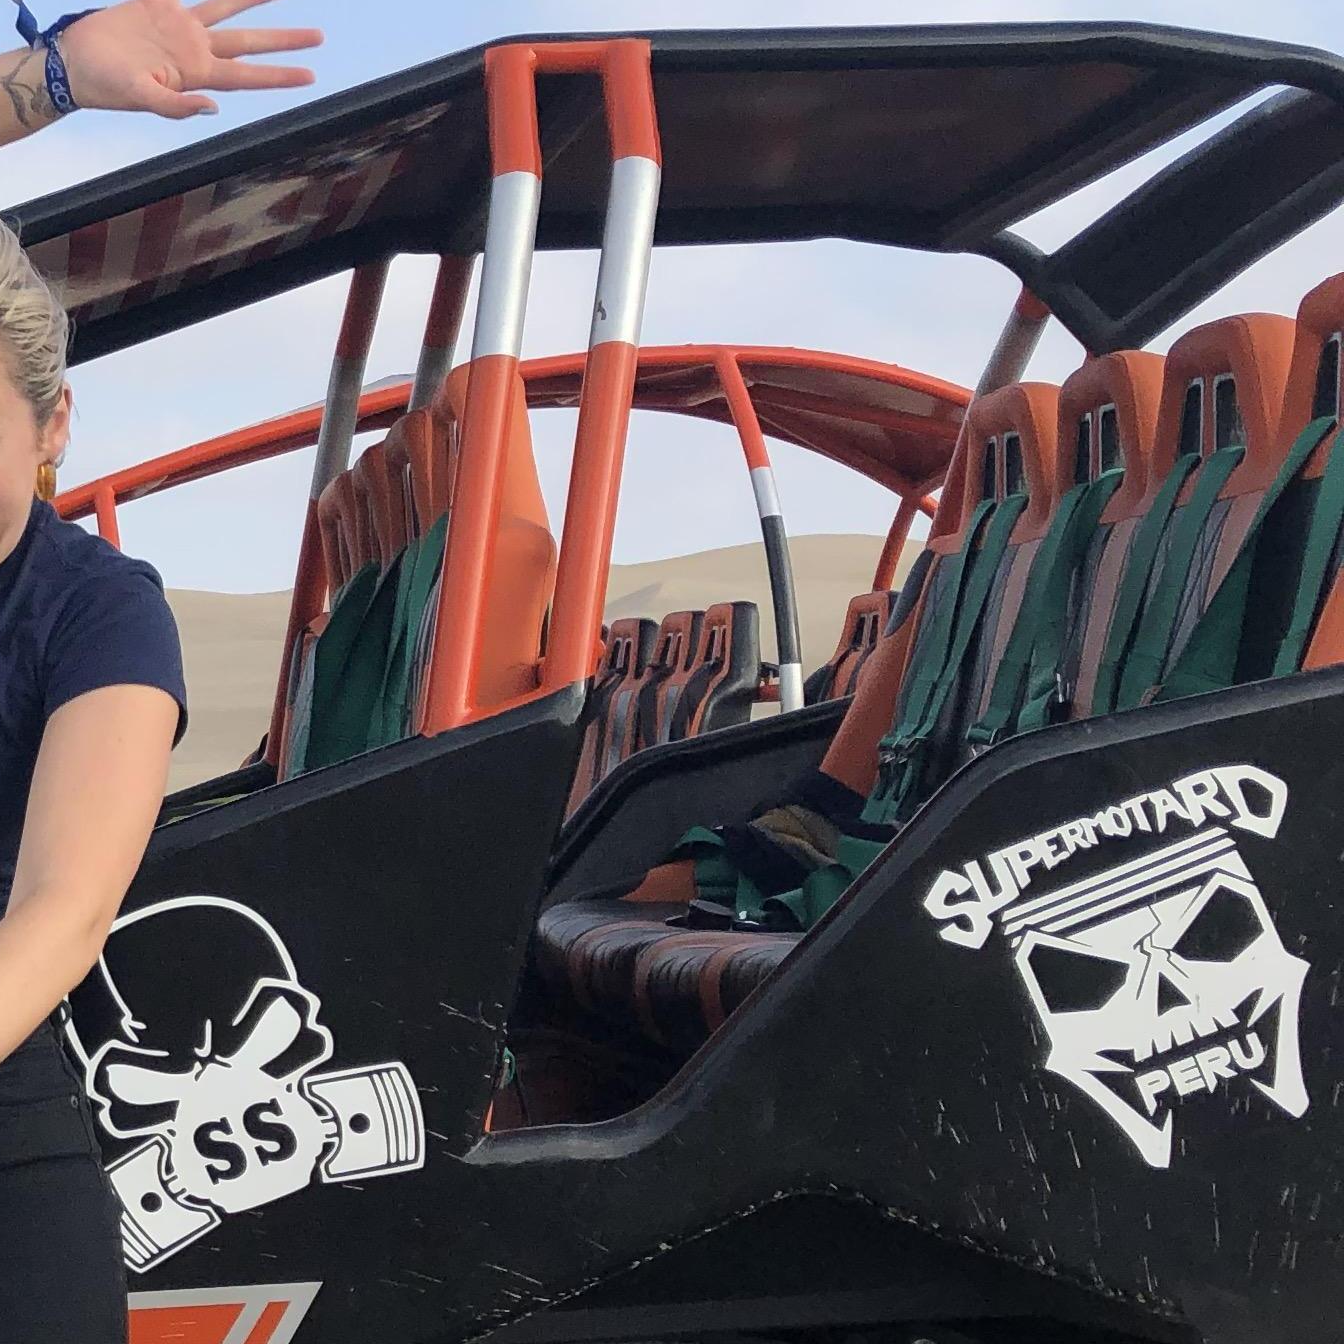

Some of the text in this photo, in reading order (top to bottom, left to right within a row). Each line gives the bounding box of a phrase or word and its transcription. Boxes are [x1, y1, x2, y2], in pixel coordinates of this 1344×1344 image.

[923, 764, 1288, 949] SUPERMOTARD
[1134, 1031, 1267, 1116] PERU
[193, 1098, 298, 1185] SS
